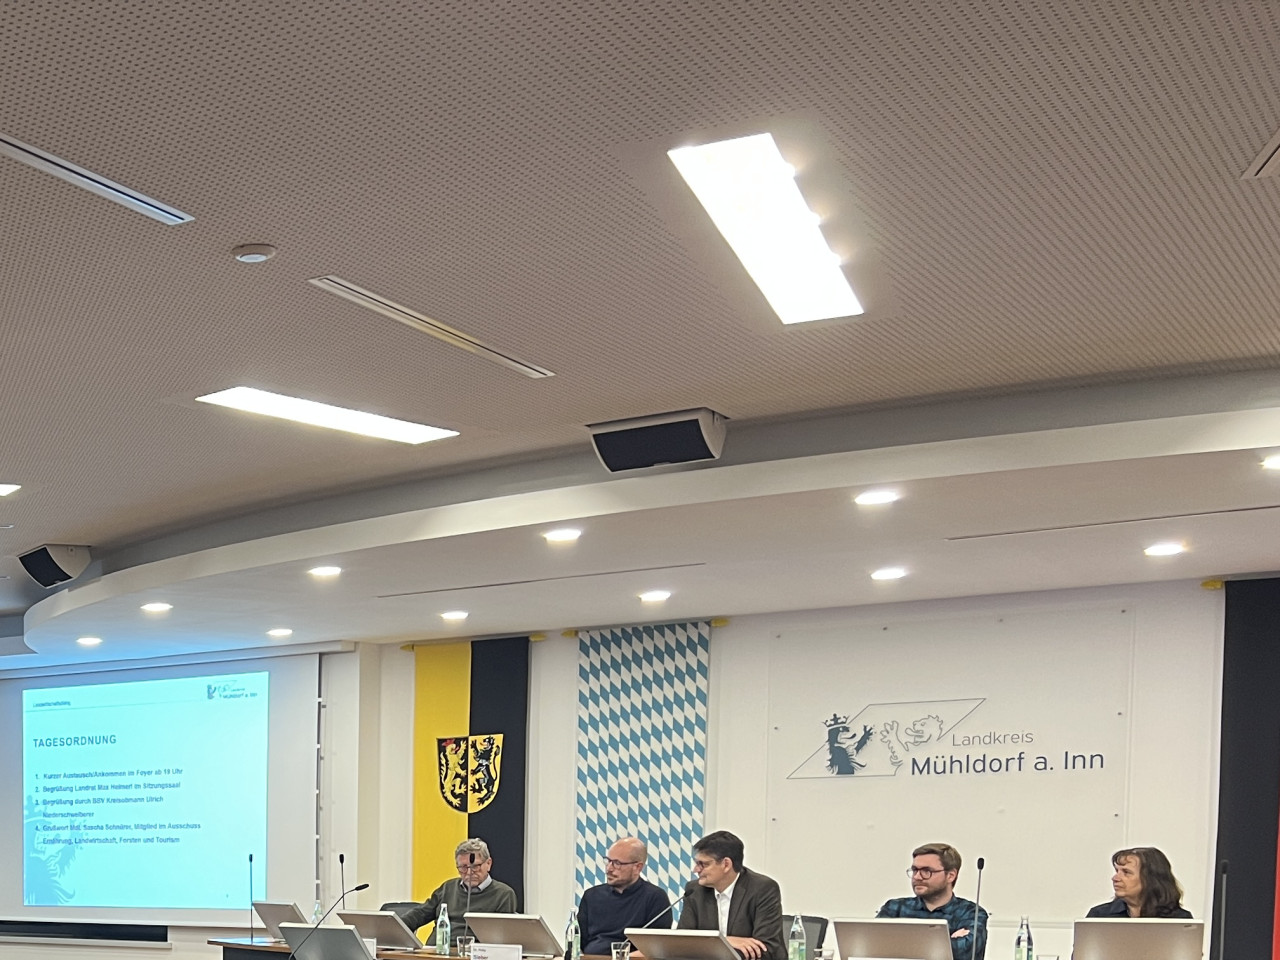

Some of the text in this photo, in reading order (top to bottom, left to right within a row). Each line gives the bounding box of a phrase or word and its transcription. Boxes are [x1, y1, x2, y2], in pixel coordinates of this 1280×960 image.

[33, 735, 117, 748] TAGESORDNUNG
[952, 731, 1034, 747] Landkreis
[911, 751, 1104, 775] Mühldorf a. Inn
[143, 781, 181, 789] Sitzungssaal
